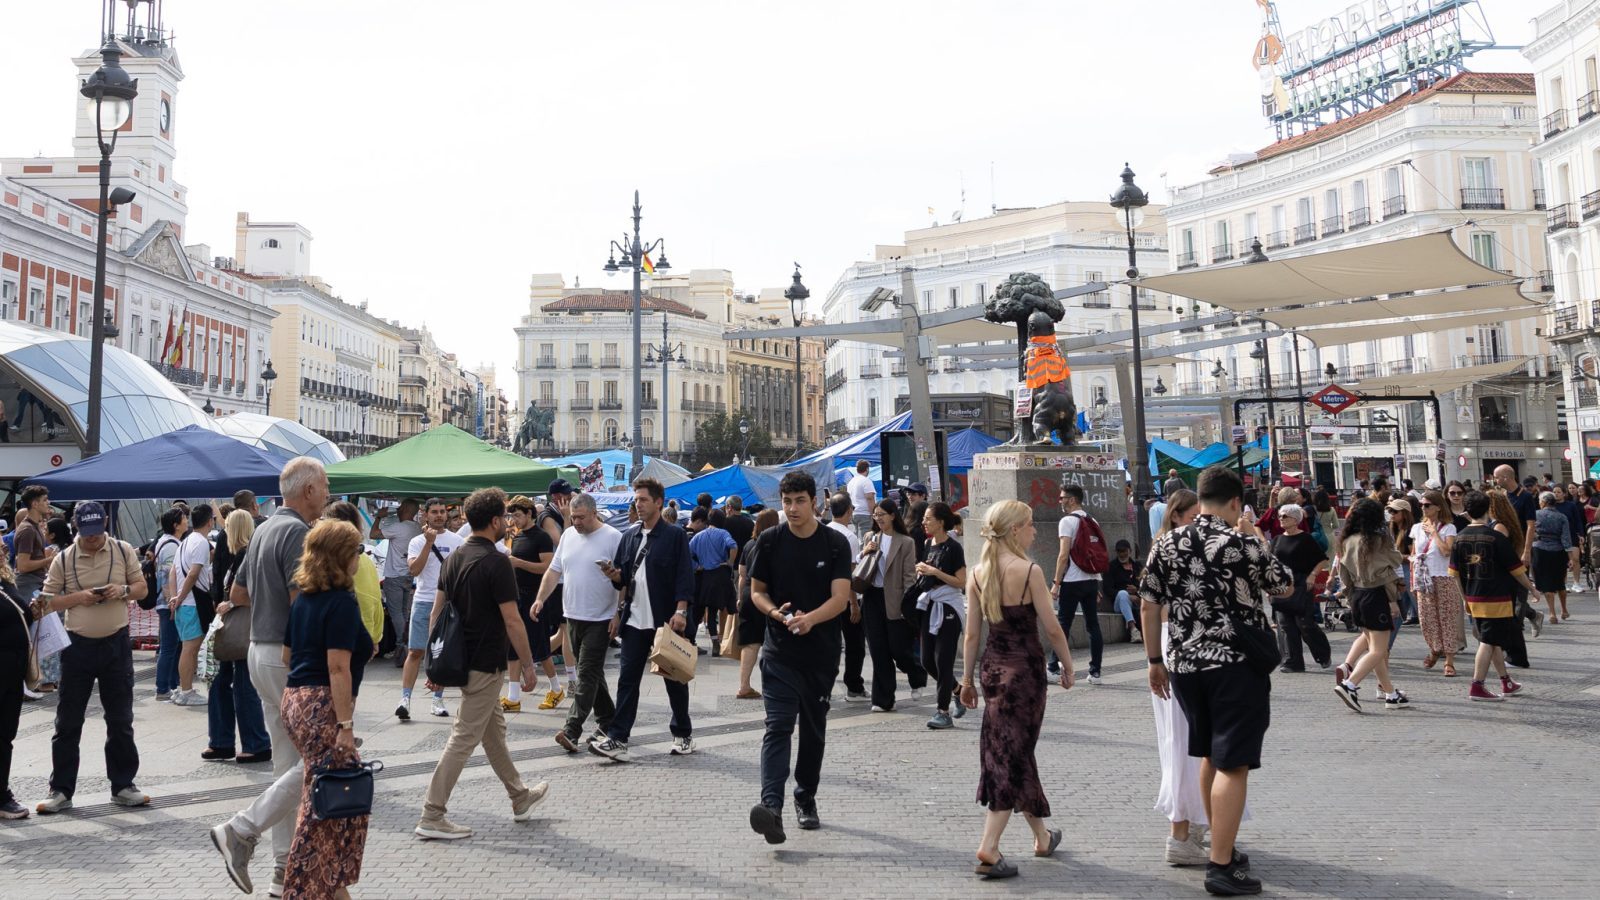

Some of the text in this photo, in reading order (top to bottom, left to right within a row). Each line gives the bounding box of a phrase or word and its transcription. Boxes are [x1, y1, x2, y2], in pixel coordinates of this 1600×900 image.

[1346, 0, 1449, 44] PEP
[1323, 395, 1345, 403] Metro
[1484, 450, 1525, 458] SEPHORA
[1062, 472, 1121, 489] EAT THE
[1082, 492, 1108, 508] ICH
